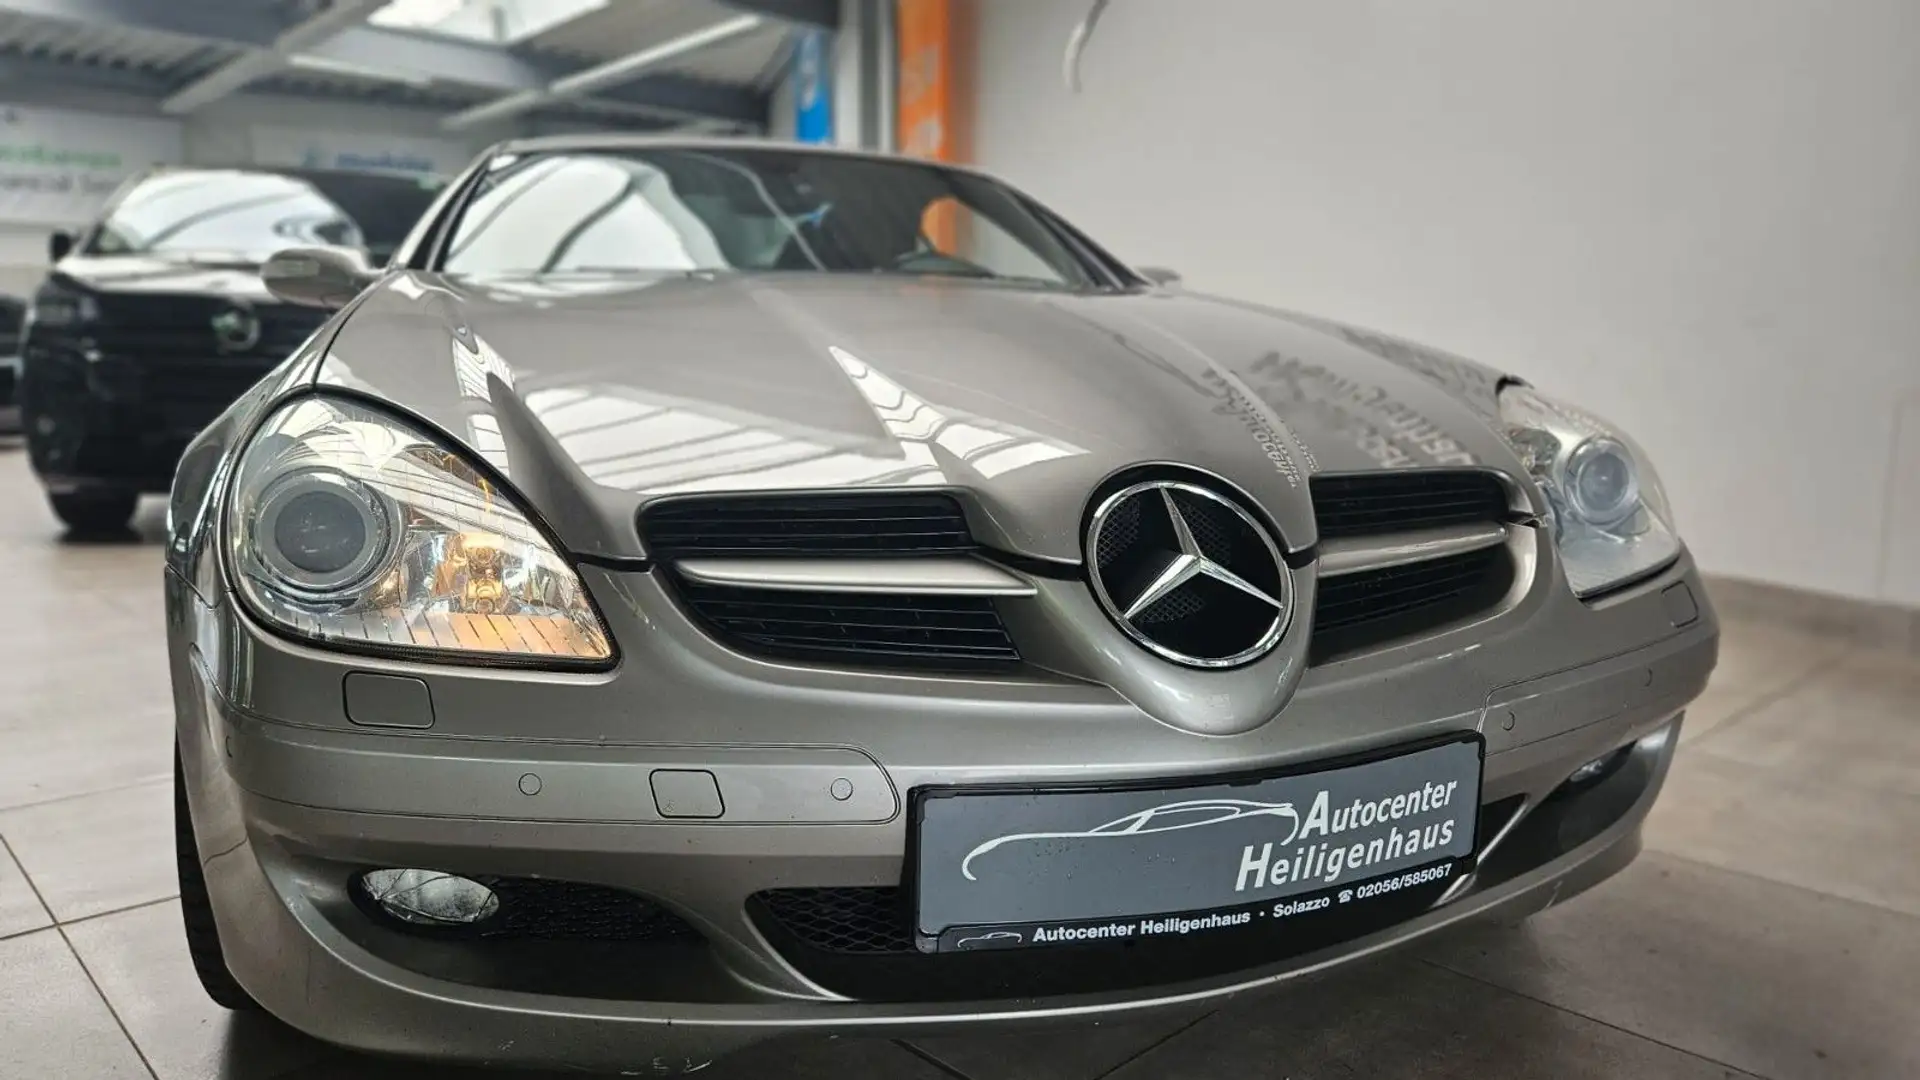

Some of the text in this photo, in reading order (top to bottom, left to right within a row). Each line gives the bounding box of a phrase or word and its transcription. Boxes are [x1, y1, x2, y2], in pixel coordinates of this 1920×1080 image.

[1298, 780, 1458, 840] Autocenter
[1235, 819, 1455, 892] Heiligenhaus
[1032, 863, 1453, 943] Autocenter Heiligenhaus Solazzo 02056/585067
